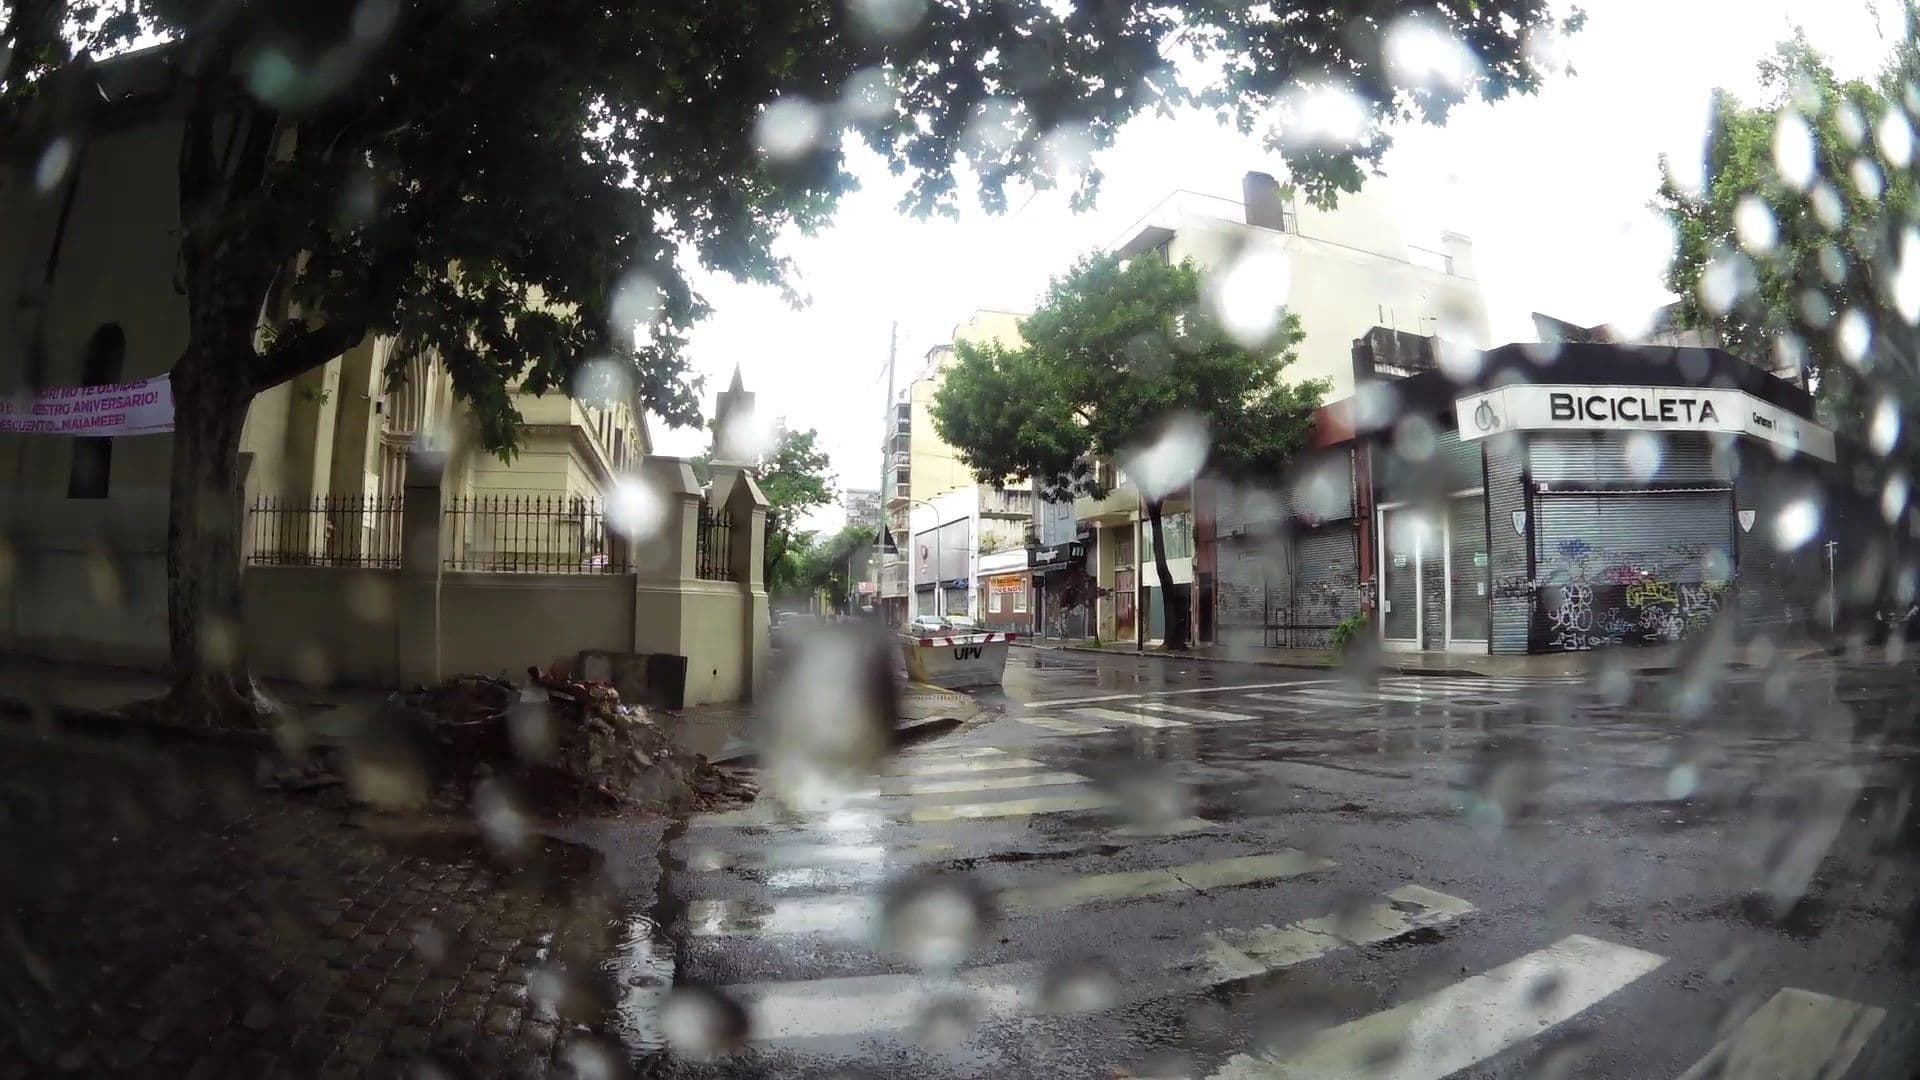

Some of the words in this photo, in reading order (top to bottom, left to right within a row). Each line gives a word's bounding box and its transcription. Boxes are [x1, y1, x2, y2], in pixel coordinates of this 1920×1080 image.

[80, 384, 97, 397] TE
[1549, 393, 1719, 423] BICICLETA
[954, 646, 982, 661] UPV
